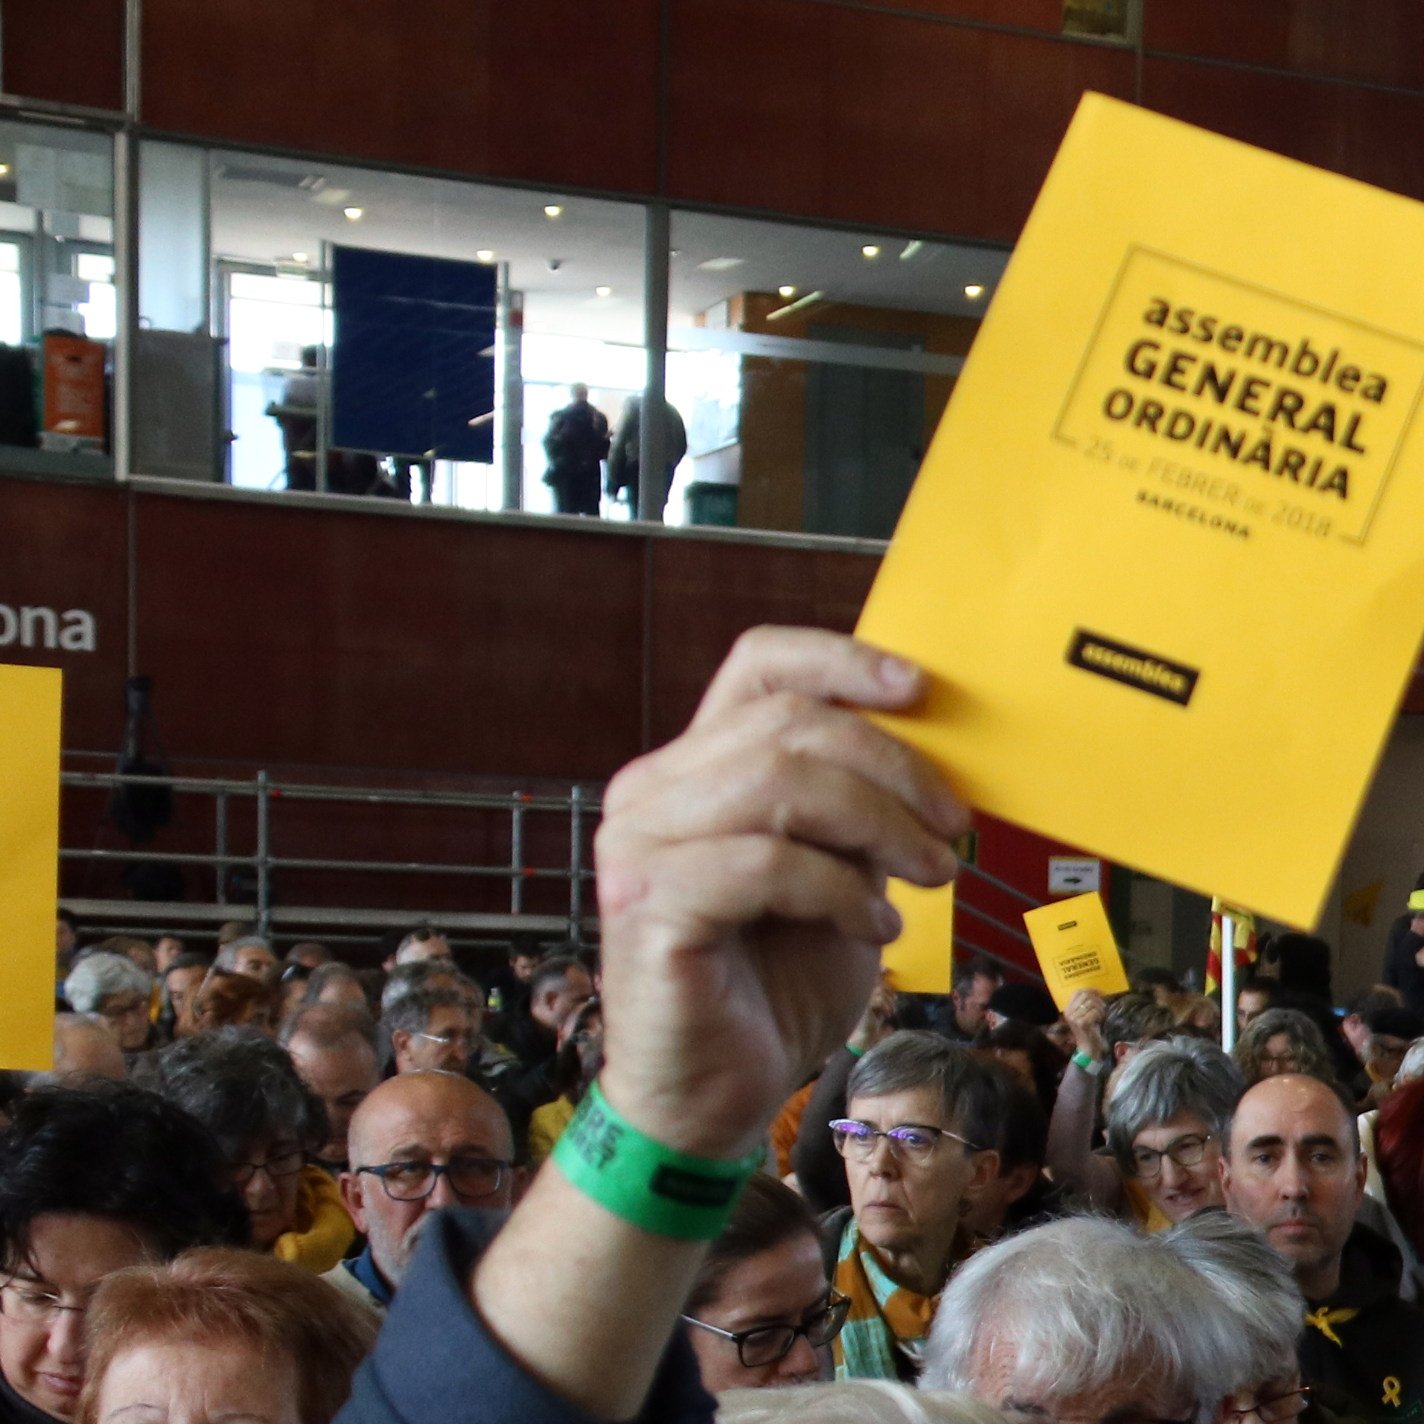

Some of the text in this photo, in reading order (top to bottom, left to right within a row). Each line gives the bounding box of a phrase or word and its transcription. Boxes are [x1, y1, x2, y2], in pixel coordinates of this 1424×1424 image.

[1124, 339, 1366, 454] GENERAL
[1143, 296, 1388, 403] assemblea
[1083, 433, 1112, 465] 25
[1145, 457, 1240, 504] FEBRER
[1272, 503, 1334, 539] 2018
[1103, 388, 1349, 500] ORDINÀRIA
[1134, 490, 1251, 540] BARCELONA
